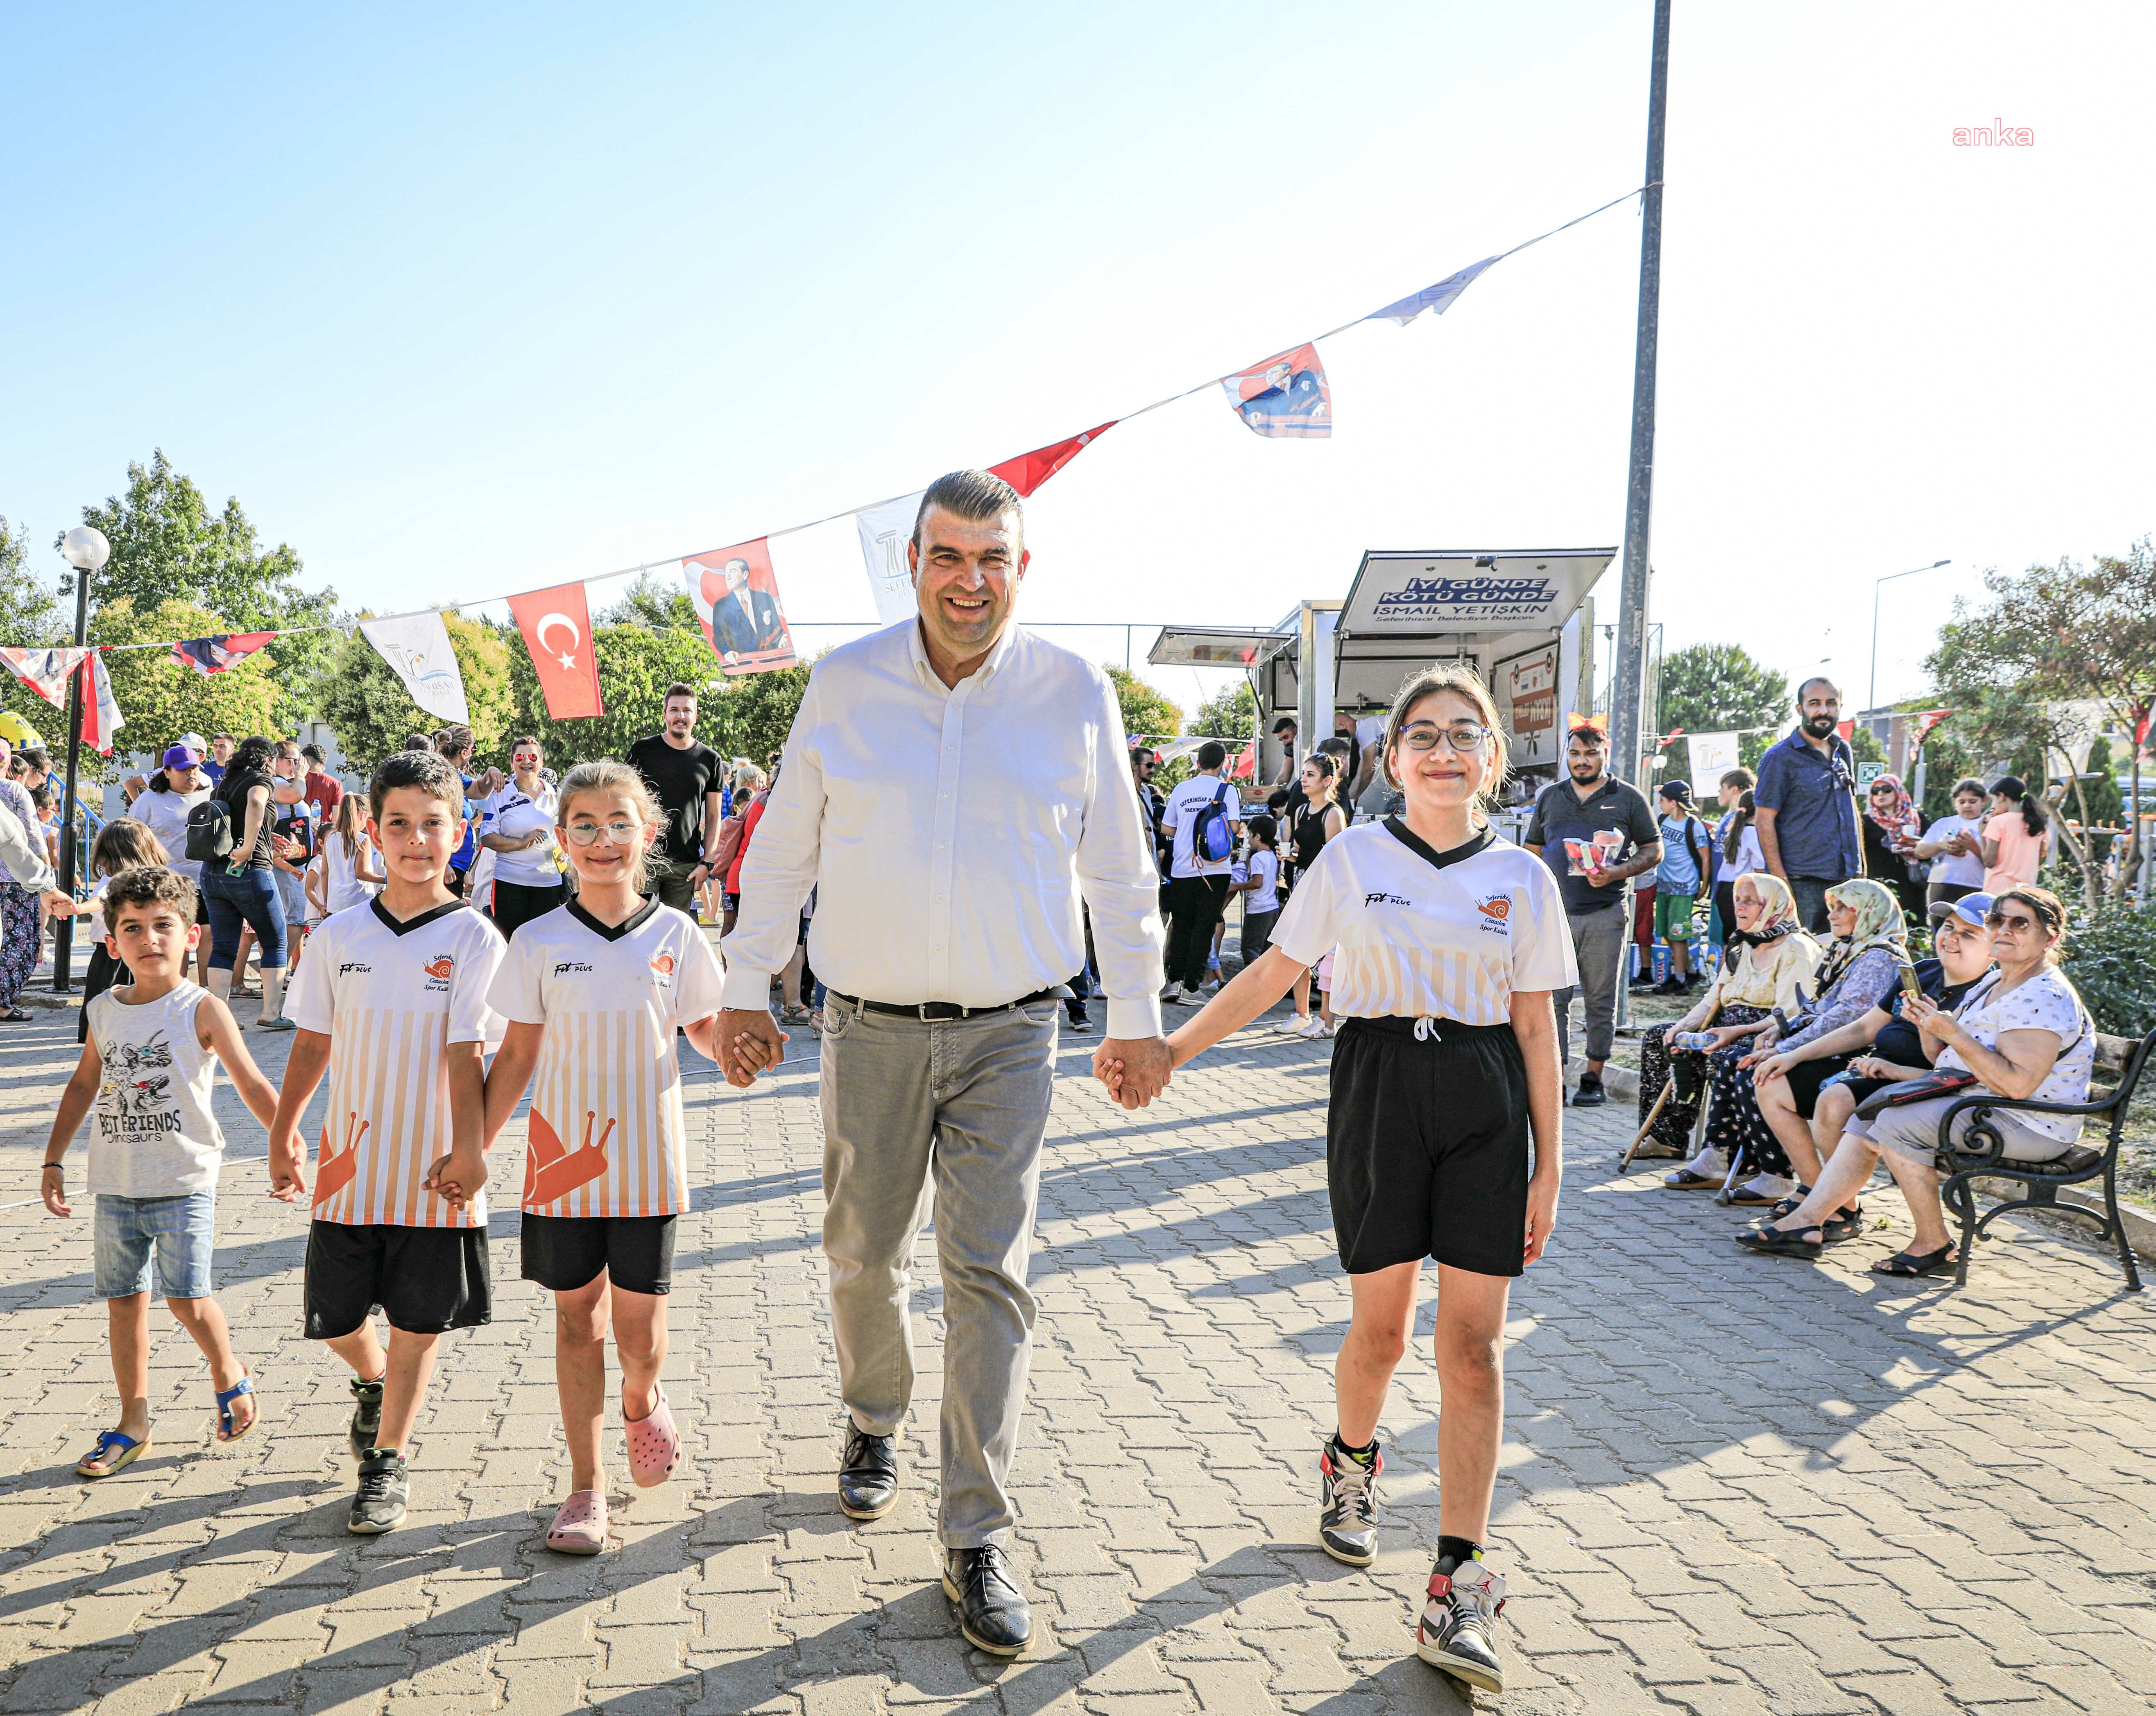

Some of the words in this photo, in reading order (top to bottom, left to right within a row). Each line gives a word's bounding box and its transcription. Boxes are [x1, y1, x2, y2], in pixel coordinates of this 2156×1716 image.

[1408, 578, 1443, 589] İYİ
[1449, 578, 1547, 589] GÜNDE
[1381, 591, 1454, 601] KÖTÜ
[1461, 590, 1556, 600] GÜNDE
[1373, 605, 1441, 615] İSMAİL
[1452, 604, 1548, 615] YETİŞKİN
[1391, 898, 1411, 906] PLUS
